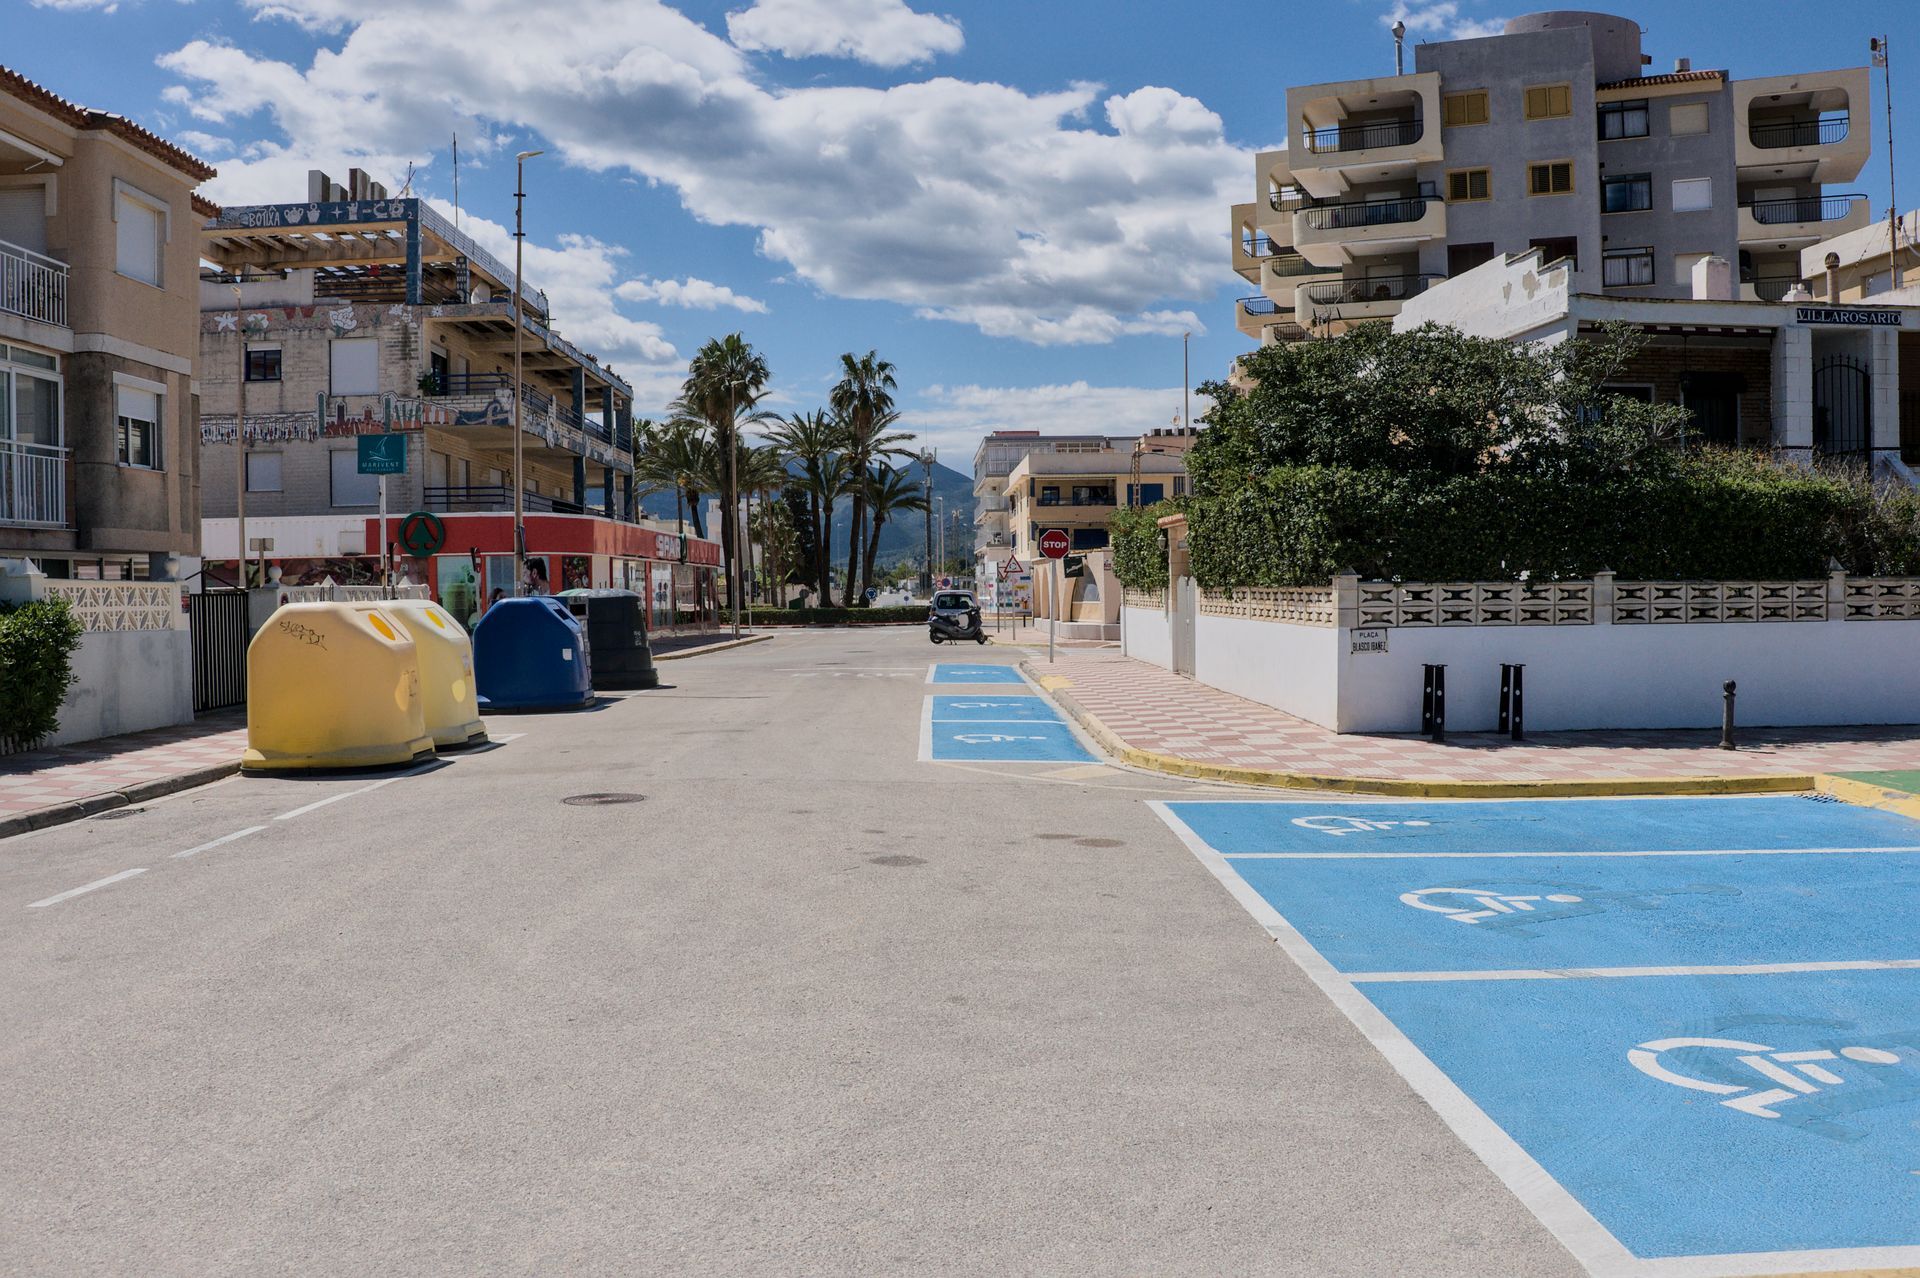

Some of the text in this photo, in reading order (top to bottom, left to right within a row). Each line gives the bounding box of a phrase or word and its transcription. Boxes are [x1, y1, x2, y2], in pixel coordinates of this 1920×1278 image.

[656, 535, 681, 559] SPAR
[1043, 541, 1067, 549] STOP
[1353, 642, 1370, 651] BLASCO
